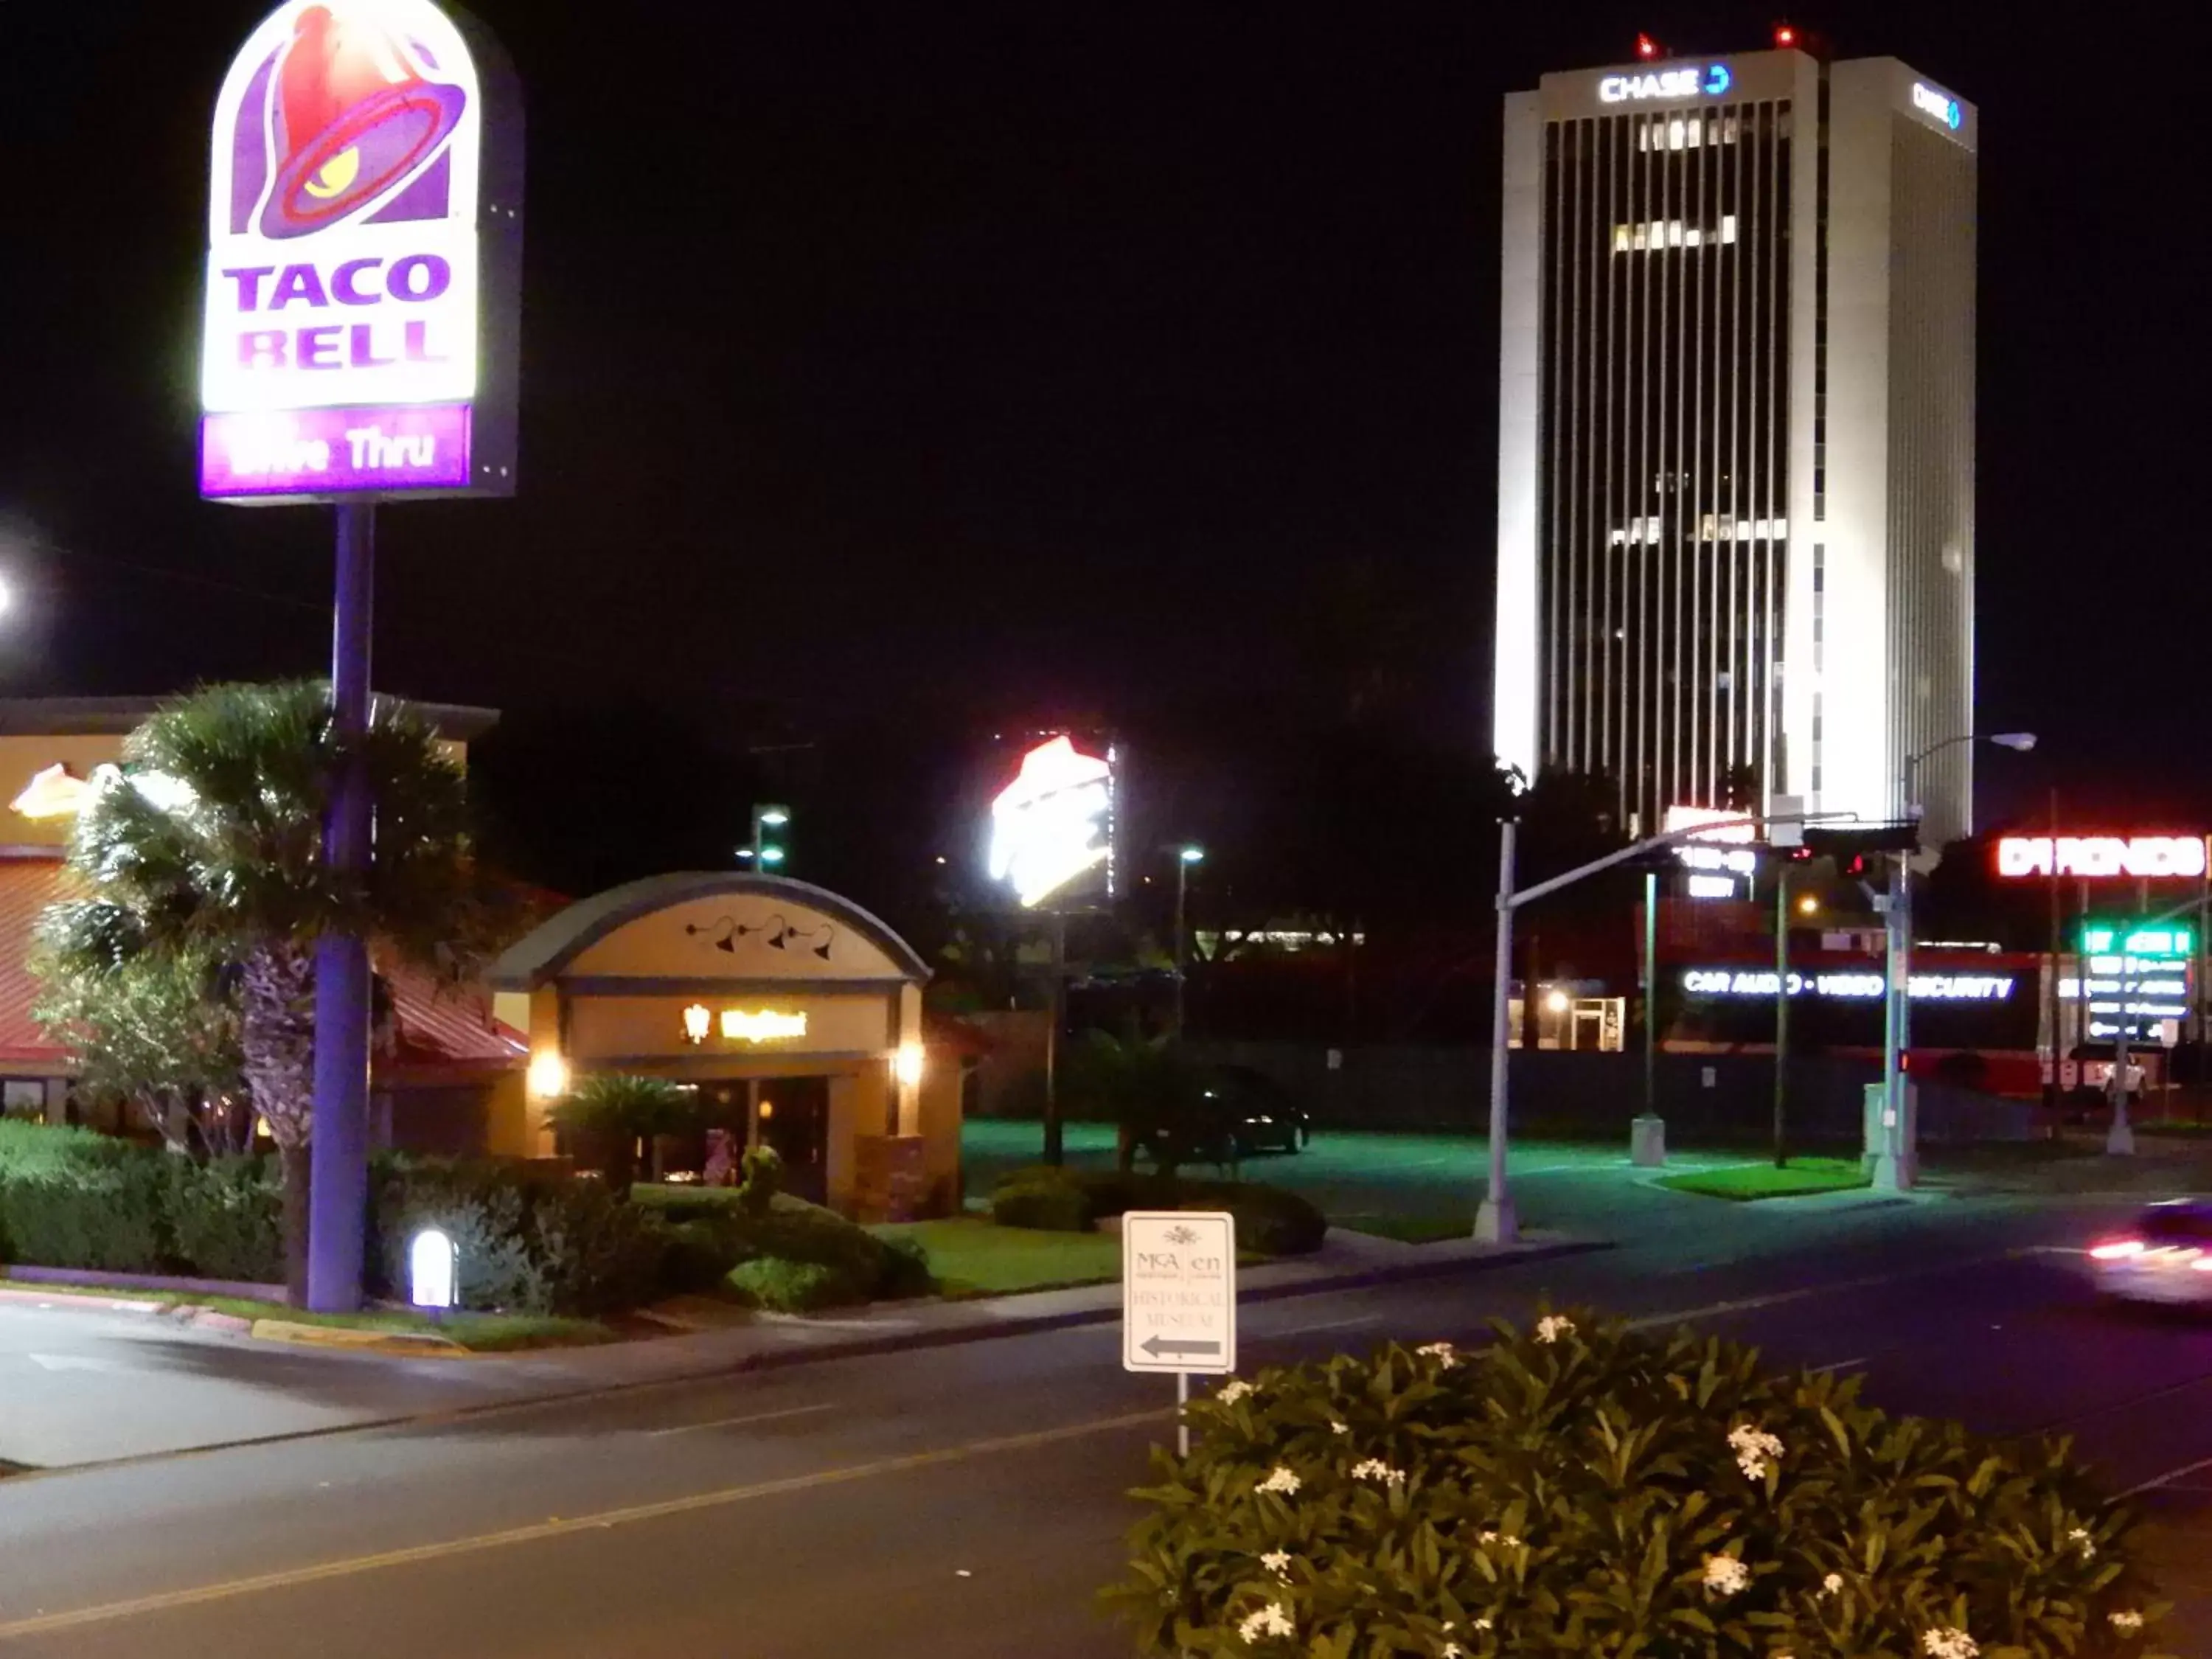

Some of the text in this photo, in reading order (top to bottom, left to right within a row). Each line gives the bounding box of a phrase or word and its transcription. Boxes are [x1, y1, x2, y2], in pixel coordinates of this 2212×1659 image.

[1600, 69, 1699, 102] CHASE
[221, 253, 452, 313] TACO
[237, 320, 450, 371] BELL
[346, 425, 434, 470] Thru
[1685, 971, 1731, 992] CAR
[1817, 975, 1885, 997] VIDEO
